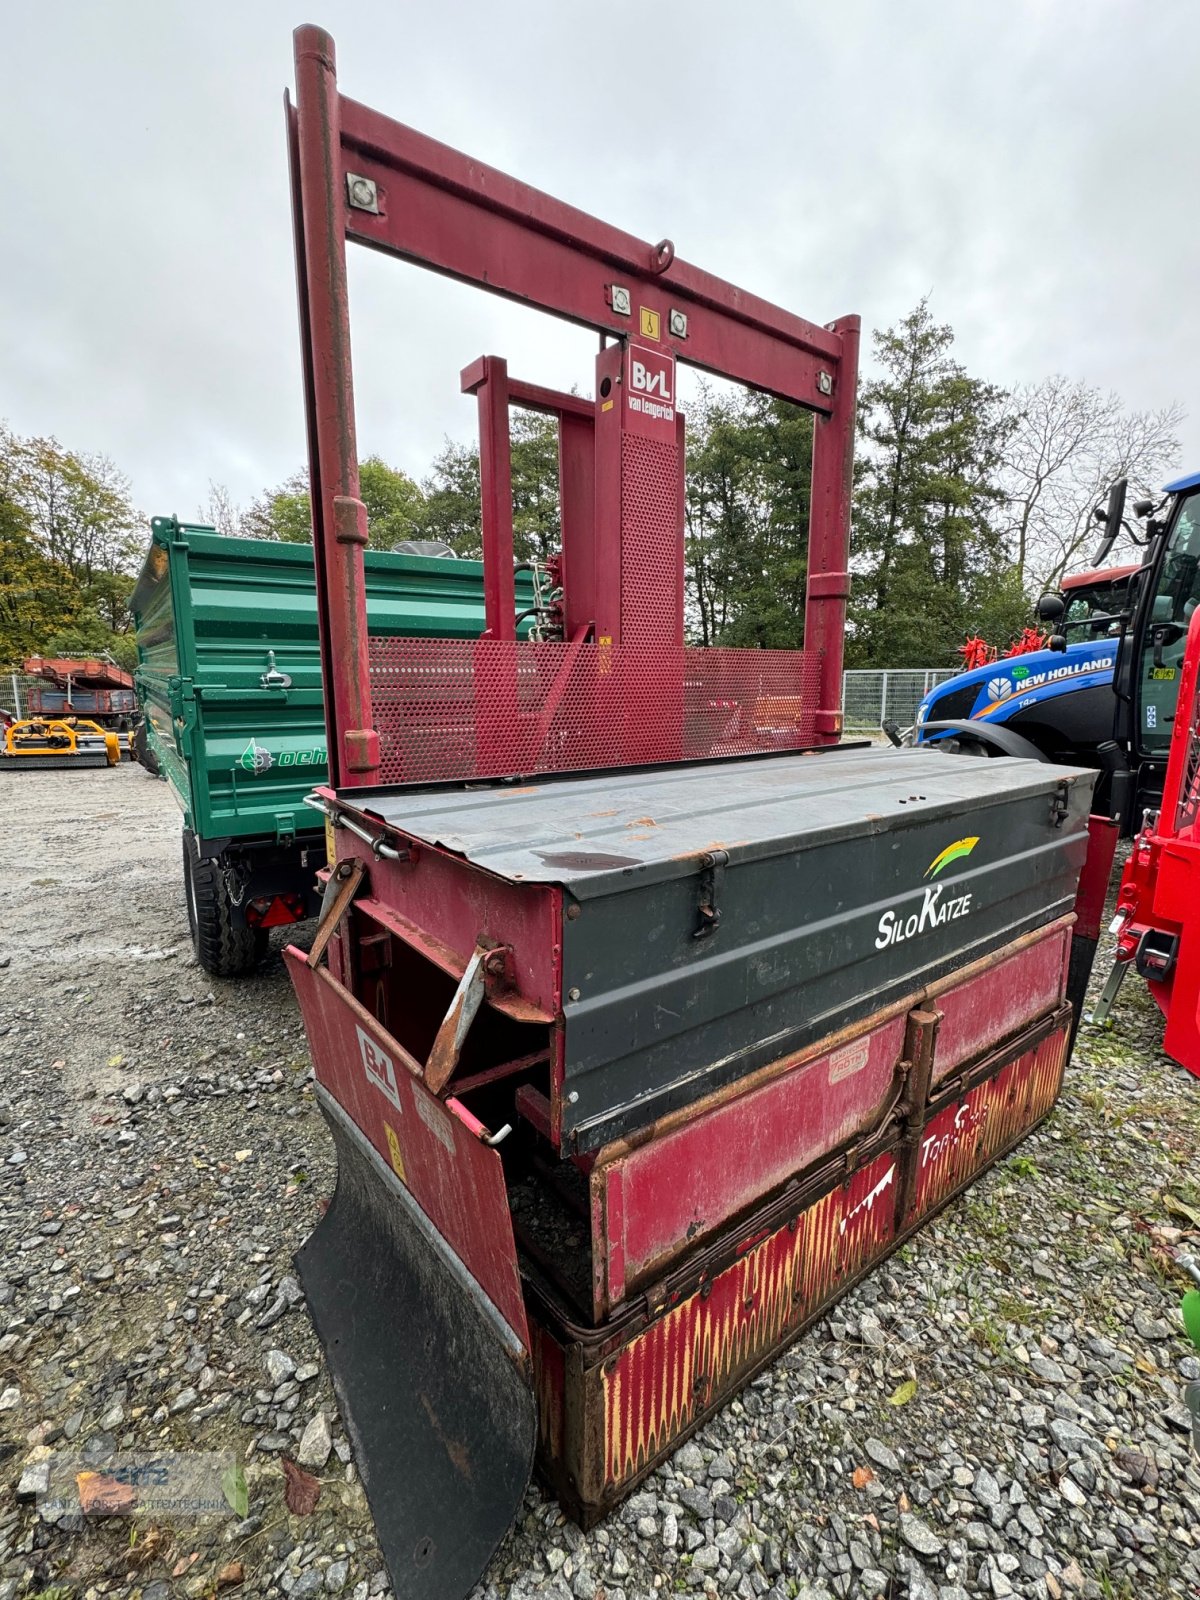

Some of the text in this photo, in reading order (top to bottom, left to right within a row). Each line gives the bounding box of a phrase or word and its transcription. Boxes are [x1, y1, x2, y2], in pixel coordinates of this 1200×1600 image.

[632, 361, 671, 399] BvL
[628, 396, 674, 422] van Lengerich
[1016, 673, 1046, 691] NEW
[1048, 657, 1112, 680] HOLLAND
[278, 747, 328, 767] oeh
